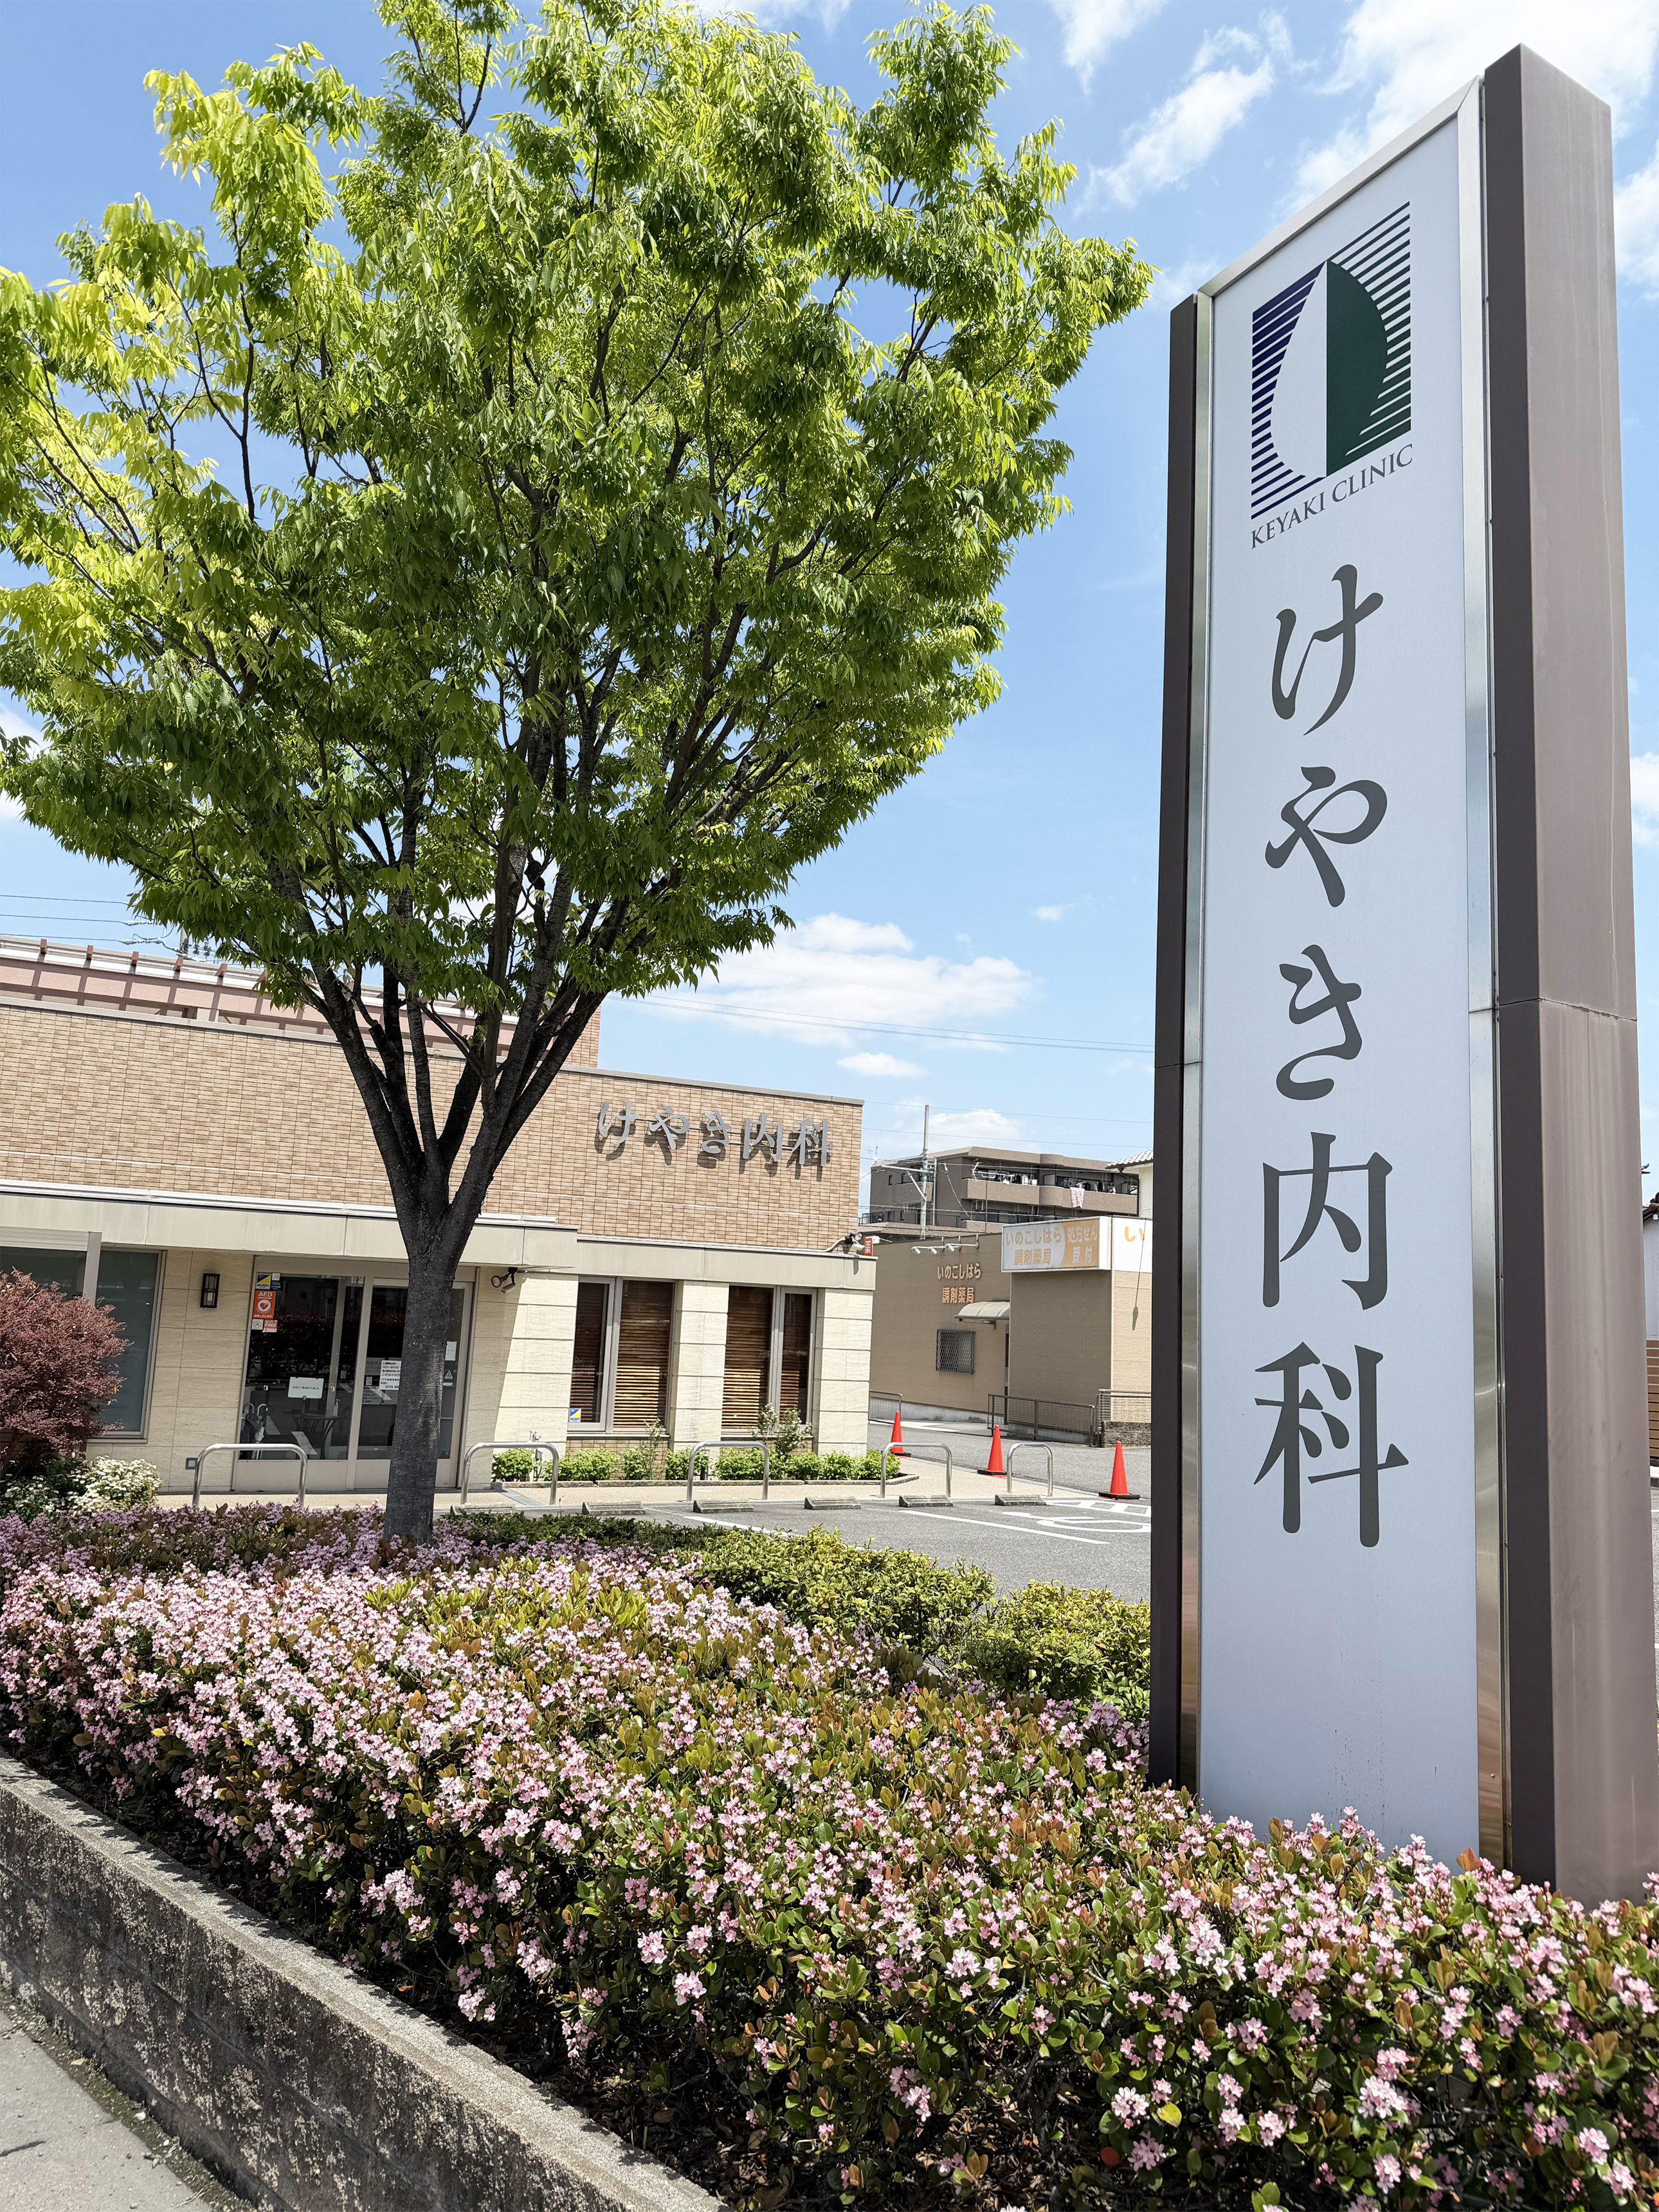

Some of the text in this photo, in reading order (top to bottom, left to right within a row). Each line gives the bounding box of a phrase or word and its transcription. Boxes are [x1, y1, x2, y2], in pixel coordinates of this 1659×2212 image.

[1251, 443, 1413, 550] KEYAKI CLINIC
[1253, 564, 1410, 1547] けやき内科
[599, 1099, 835, 1167] けやき内科
[1006, 1227, 1061, 1246] いのこしはら
[1067, 1225, 1098, 1244] 処方せん
[864, 1240, 872, 1254] 薬
[1014, 1248, 1052, 1266] 調剤薬局
[937, 1263, 981, 1280] いのこしはら
[942, 1287, 974, 1303] 調剤薬局
